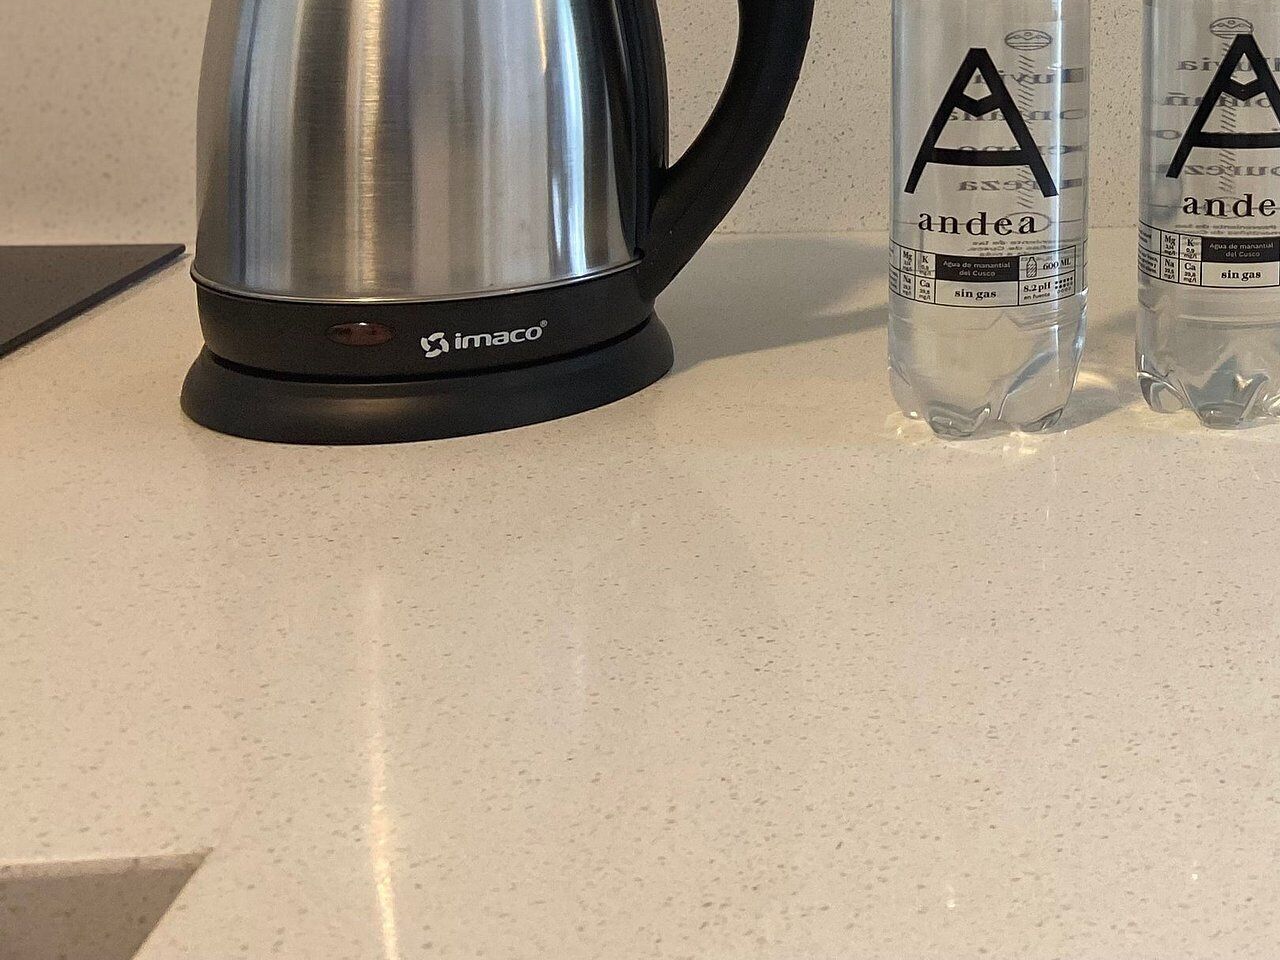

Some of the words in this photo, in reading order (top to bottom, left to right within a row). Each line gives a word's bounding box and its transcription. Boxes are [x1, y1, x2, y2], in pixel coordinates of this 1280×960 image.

[918, 211, 1038, 236] andea
[1186, 238, 1195, 247] K
[922, 255, 929, 263] K
[1042, 261, 1059, 270] 600
[1184, 262, 1197, 271] Ca
[1221, 269, 1240, 279] sin
[1241, 271, 1262, 282] gas
[919, 279, 931, 288] Ca
[1023, 284, 1037, 293] 8.2
[1038, 281, 1051, 292] pH
[954, 288, 973, 298] sin
[975, 290, 997, 301] gas
